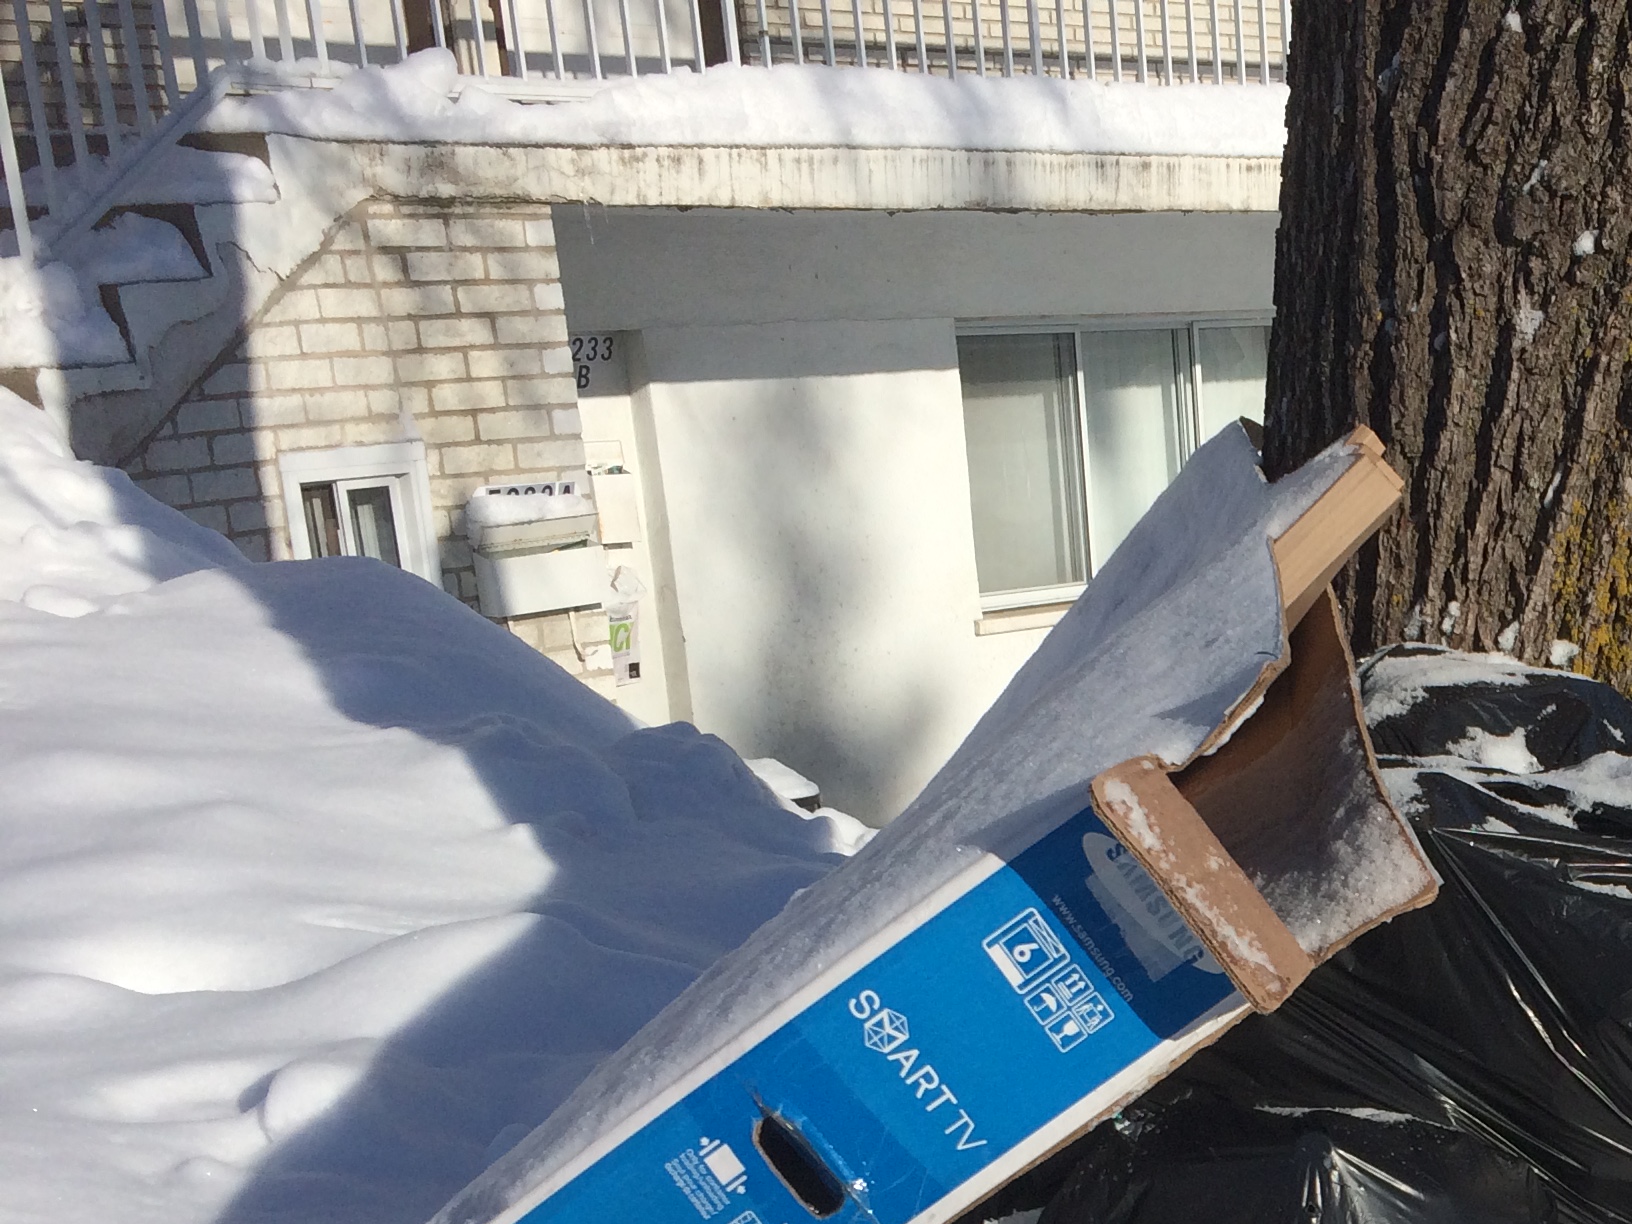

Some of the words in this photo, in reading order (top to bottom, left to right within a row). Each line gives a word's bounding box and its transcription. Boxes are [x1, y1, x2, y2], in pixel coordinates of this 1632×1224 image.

[577, 365, 590, 389] B
[1106, 843, 1205, 965] SAMSUNG
[1013, 942, 1039, 963] 6
[1052, 894, 1133, 1002] www.samsung.com
[945, 1108, 988, 1151] TV
